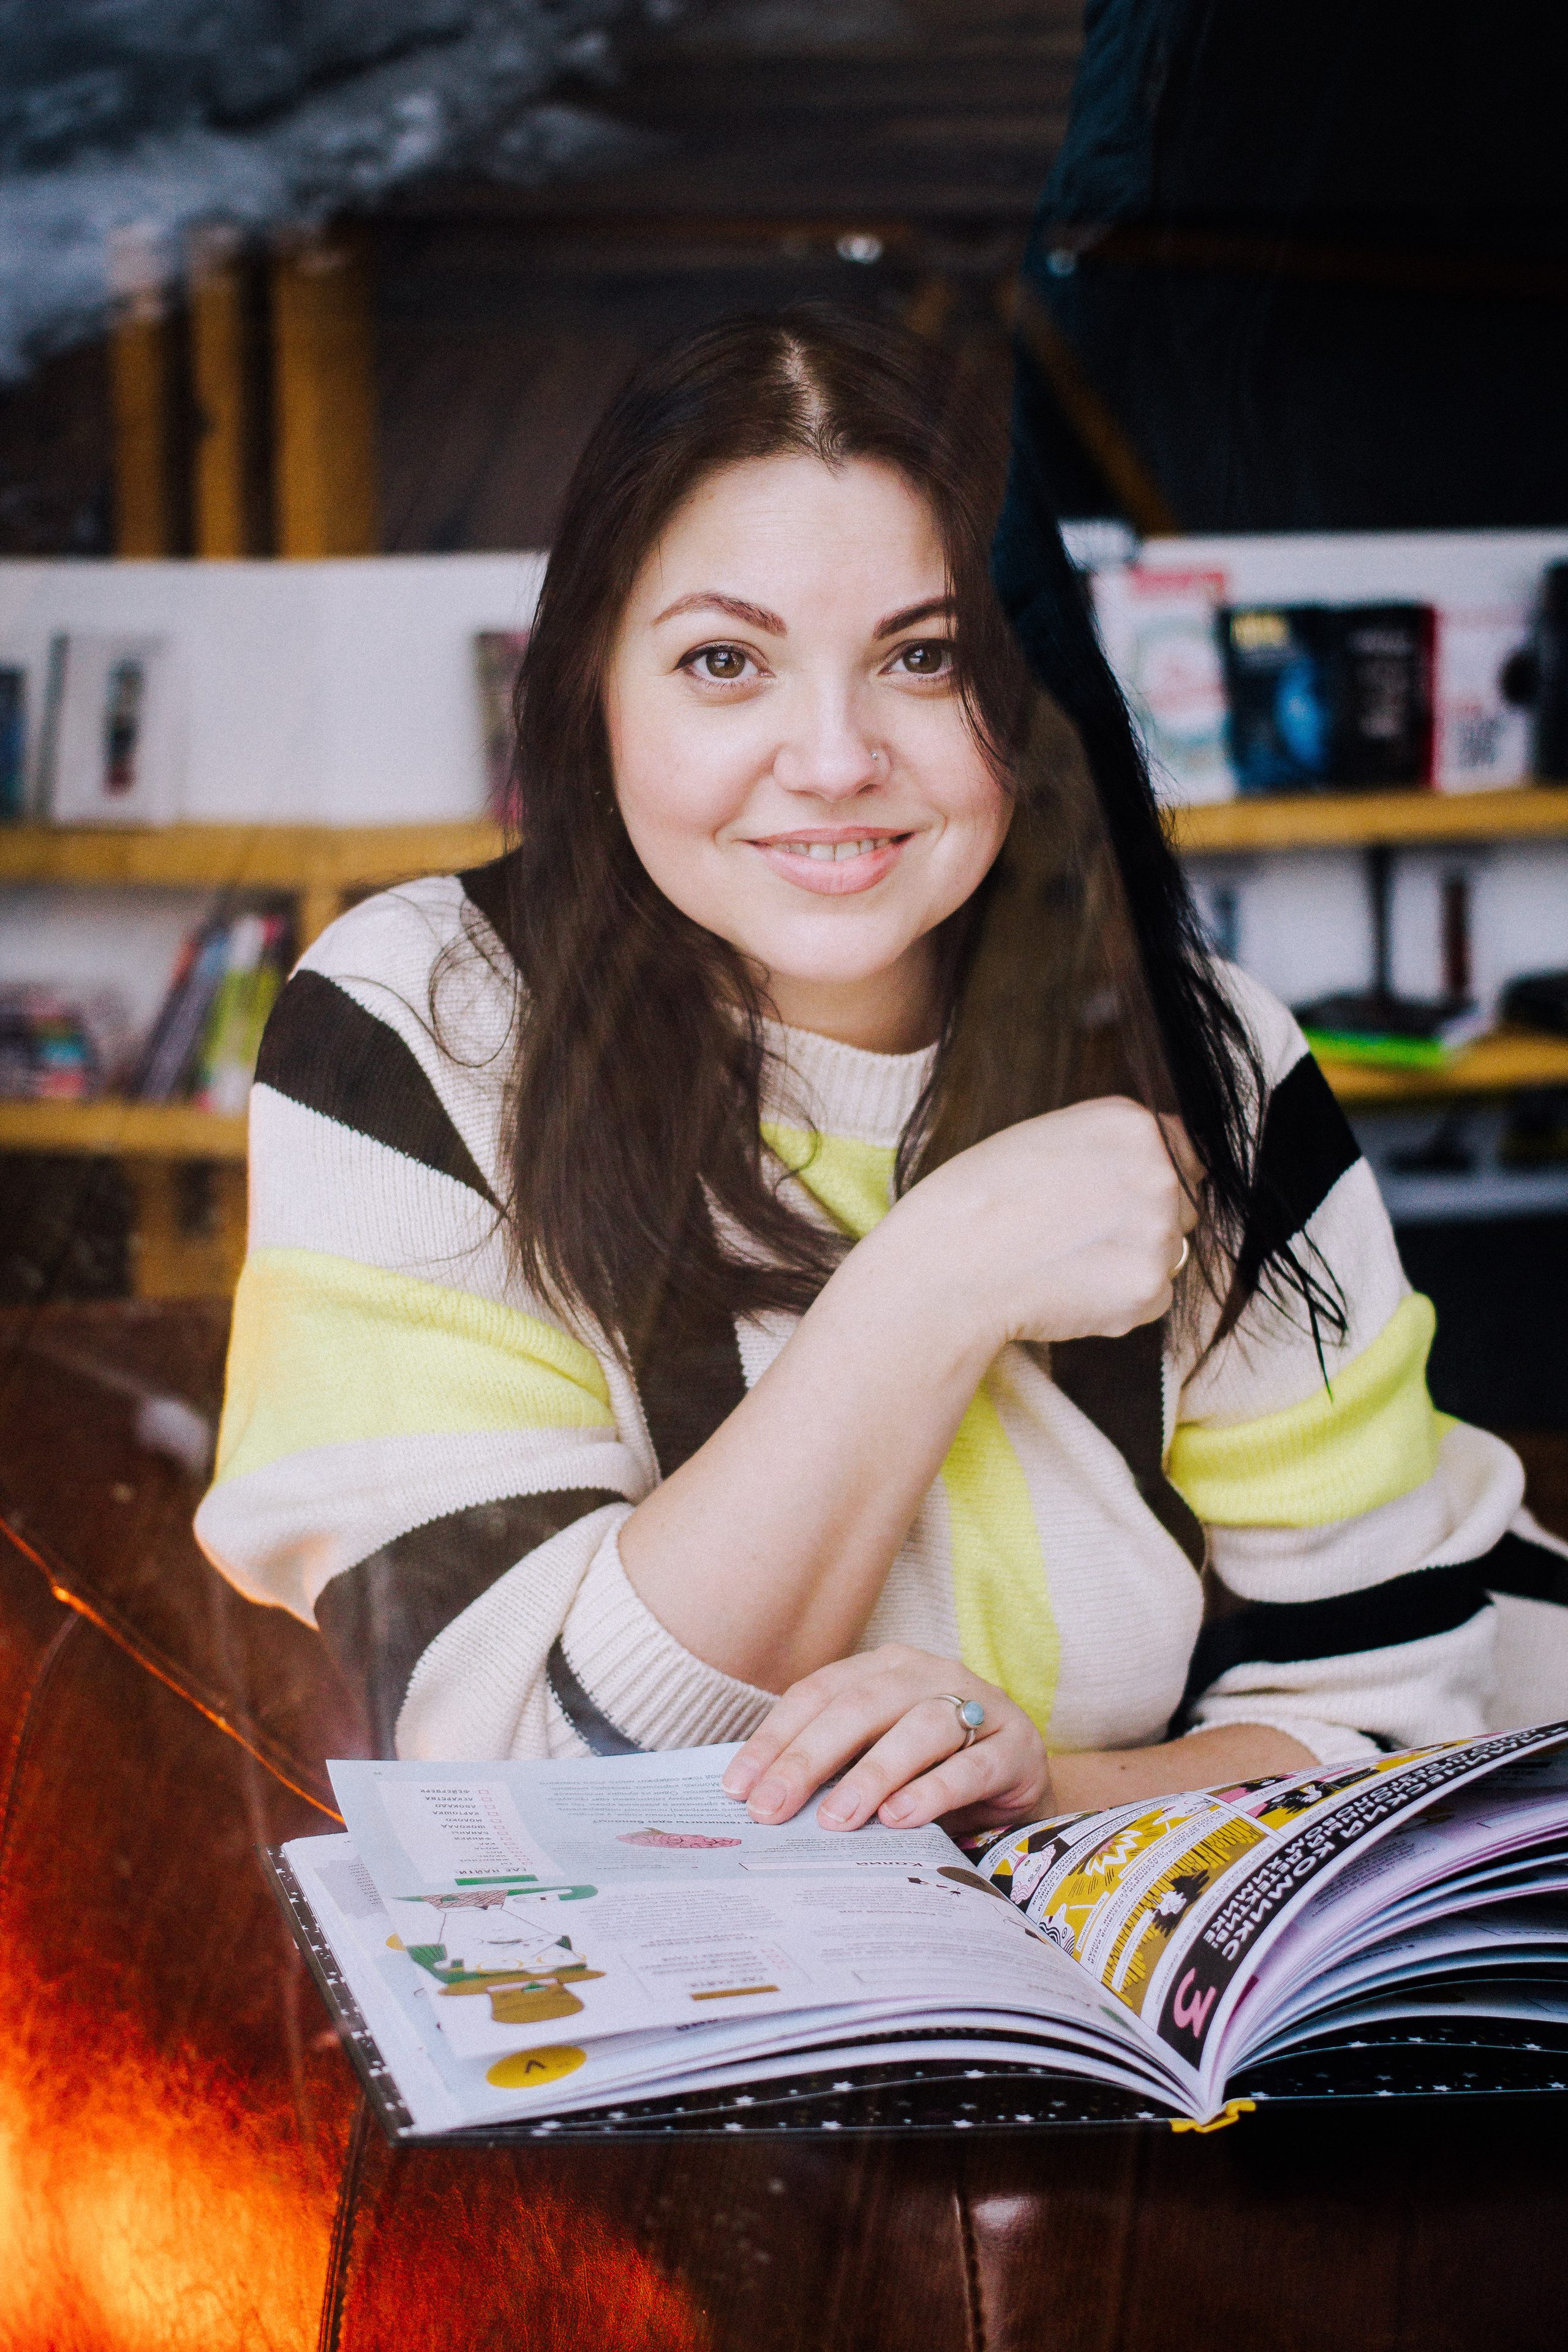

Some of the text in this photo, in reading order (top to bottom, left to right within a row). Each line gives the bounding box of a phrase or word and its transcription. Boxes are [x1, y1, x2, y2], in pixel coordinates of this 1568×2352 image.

[1337, 1729, 1566, 1845] ХИМИЧЕСКИЙ
[1188, 1811, 1220, 1830] ВЫХОДИТ
[1292, 1763, 1439, 1851] БЕЗГОЛОВОМ
[1101, 1813, 1142, 1838] АНГЛИЙСКИЙ
[1173, 1815, 1215, 1844] ФЛОГИСТОНЕ
[1200, 1826, 1218, 1838] ОТЕЦ
[1058, 1833, 1100, 1871] ПОДДЕРЖИВАЛ
[1078, 1838, 1099, 1856] ХИМИК
[1147, 1851, 1159, 1863] ПРИ
[1158, 1831, 1186, 1854] НАРУЖУ
[1159, 1828, 1200, 1861] ВМЕШАЛИСЬ
[1186, 1839, 1199, 1850] БЫЛ
[1055, 1855, 1078, 1881] ДЖОЗЕФ
[1129, 1861, 1159, 1893] АЛХИМИКИ
[1134, 1851, 1164, 1881] ОГНЕННОЙ
[1156, 1851, 1185, 1877] БОГАТЫМ
[1031, 1871, 1055, 1905] ВОЗДУХОМ.
[1037, 1882, 1055, 1912] ПРИСТЛИ
[1038, 1872, 1058, 1899] ГОРЕНИЕ.
[1204, 1856, 1283, 1943] ХИМИКЕ
[1209, 1848, 1305, 1949] ДЕТЕКТИВ:
[1101, 1882, 1134, 1926] СУБСТАНЦИИ,
[1117, 1878, 1156, 1928] АРИСТОКРАТОМ.
[1219, 1841, 1336, 1963] КОМИКС
[1077, 1898, 1106, 1948] Ты пустозвон!
[1101, 1900, 1125, 1937] БЕЗУМНОЙ
[1086, 1929, 1102, 1961] КОТОРАЯ
[1090, 1940, 1102, 1964] ИДЕЕЙ
[1177, 1967, 1216, 2038] 3
